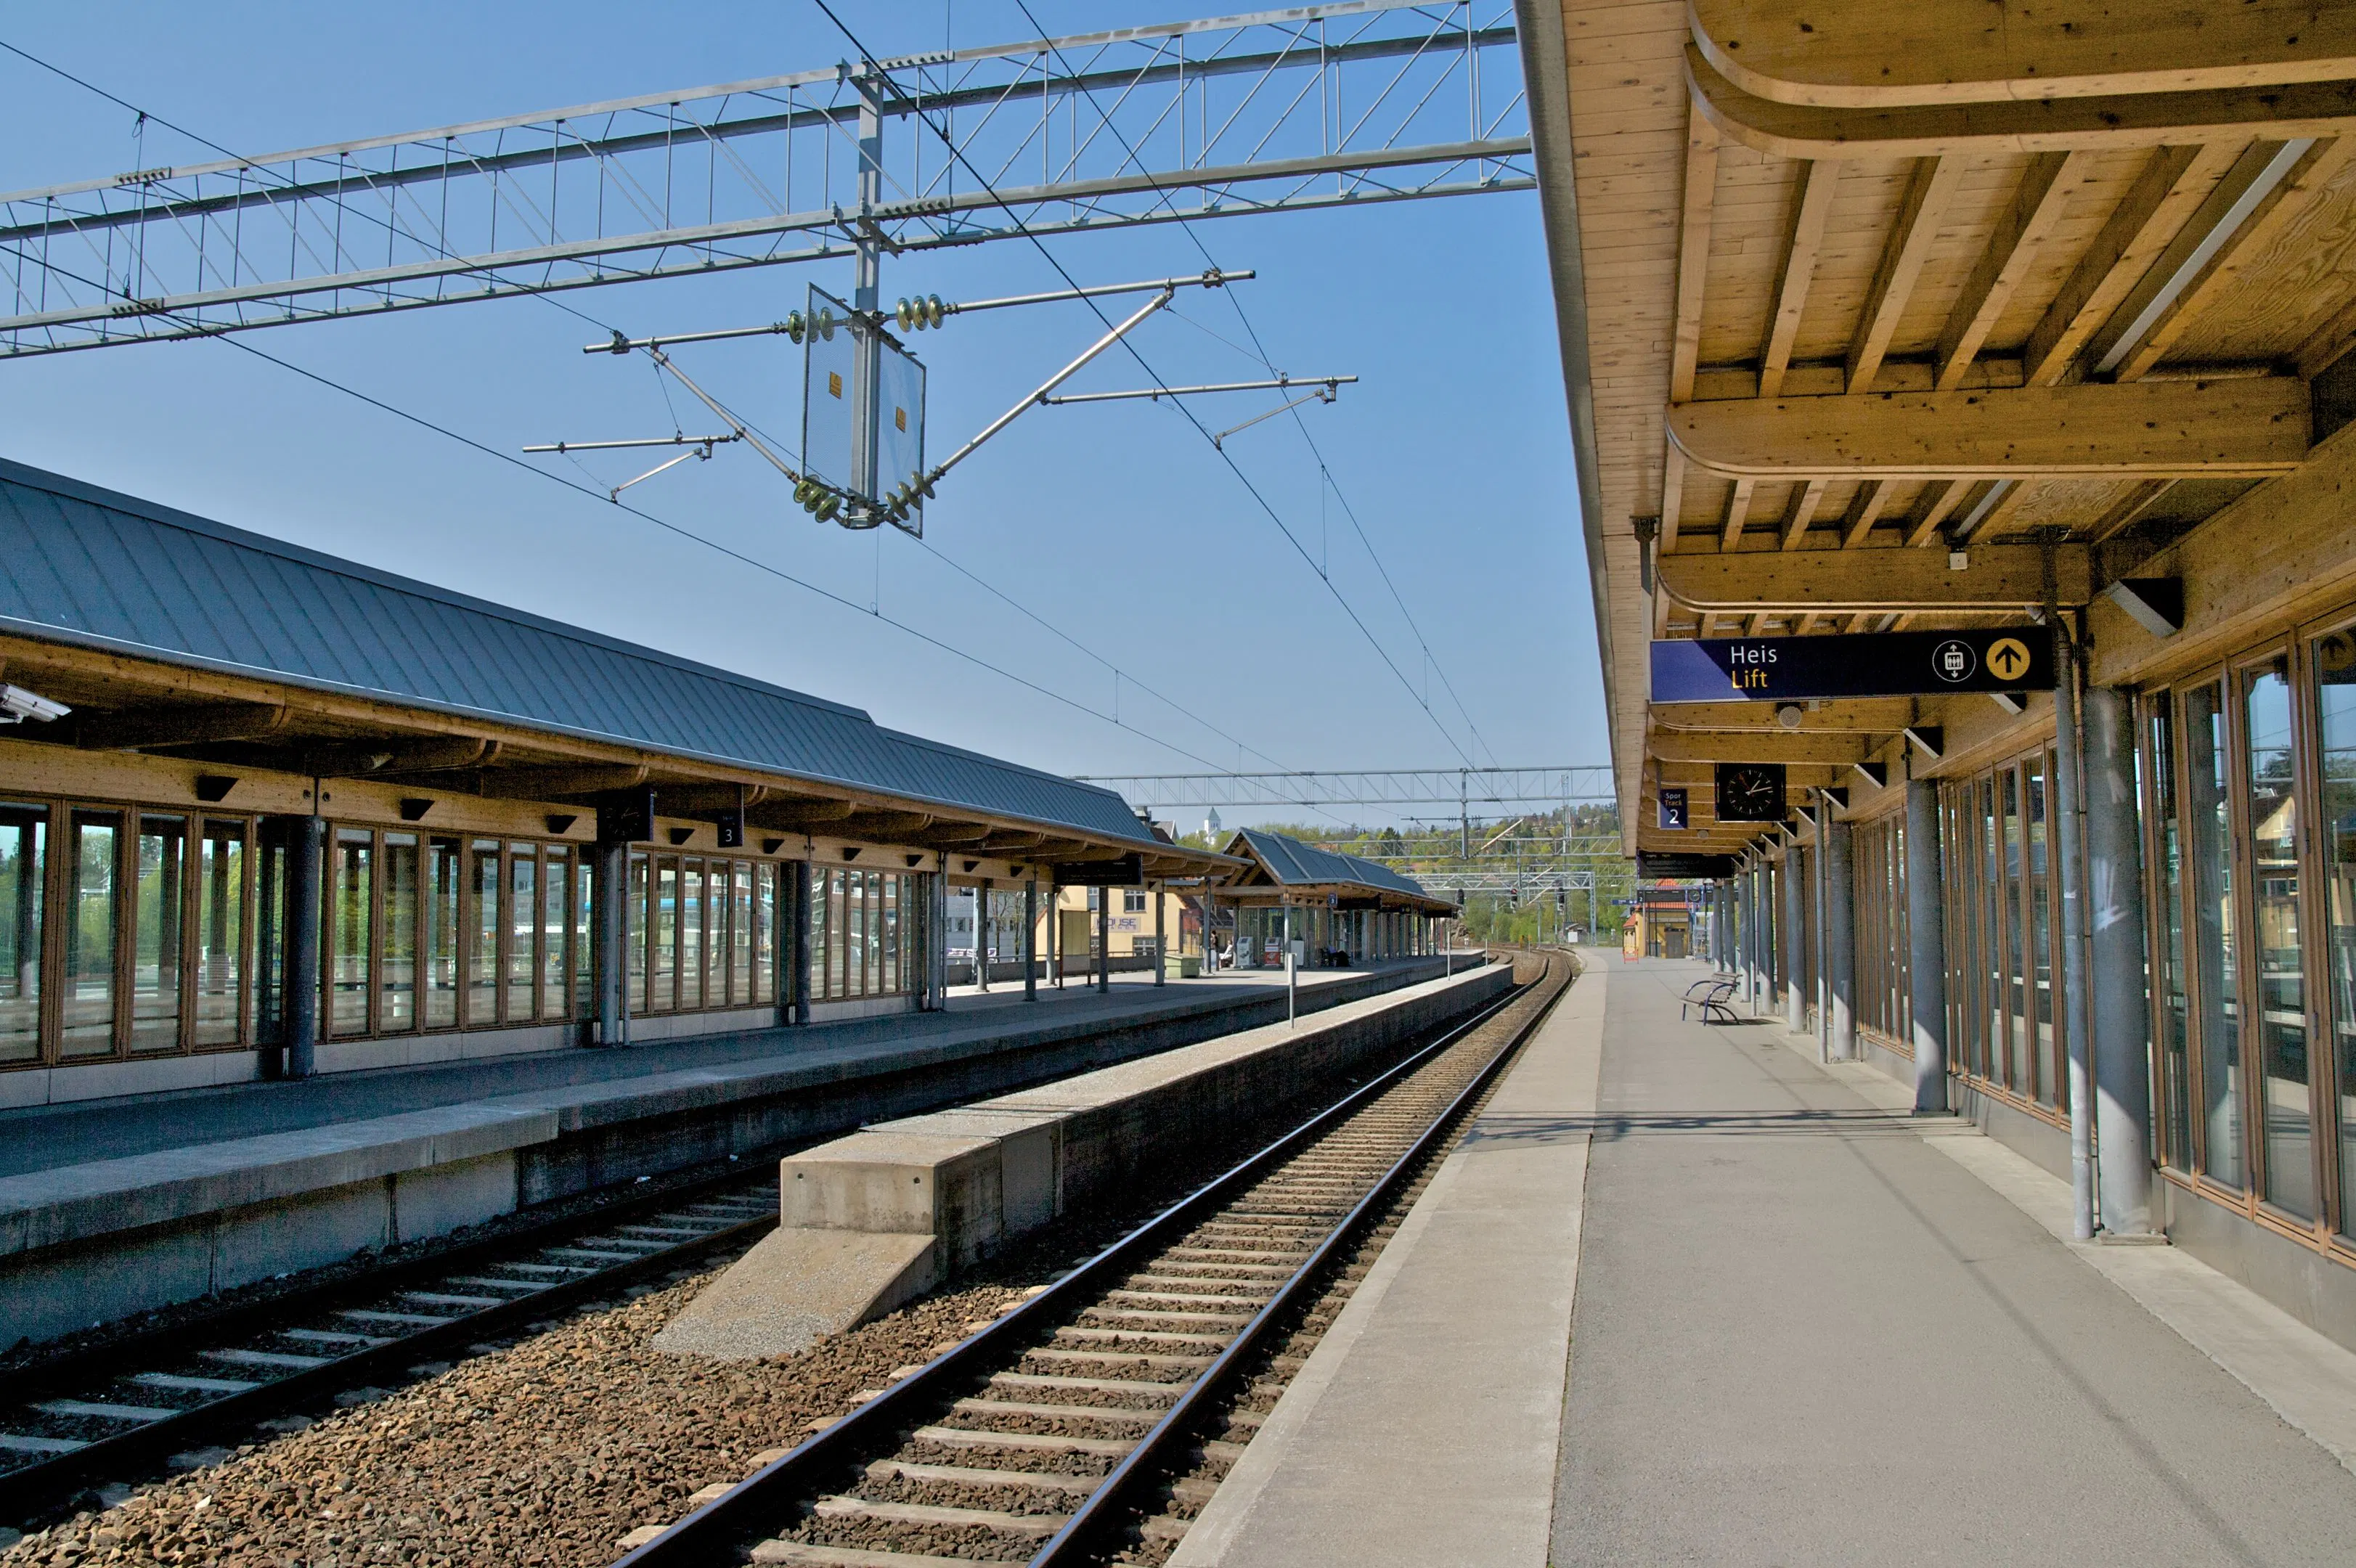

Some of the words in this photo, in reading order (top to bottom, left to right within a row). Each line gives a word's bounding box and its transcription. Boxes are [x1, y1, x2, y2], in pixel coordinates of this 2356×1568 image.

[1731, 645, 1777, 664] Heis
[1732, 669, 1768, 689] Lift
[1669, 809, 1679, 824] 2
[725, 829, 733, 842] 3
